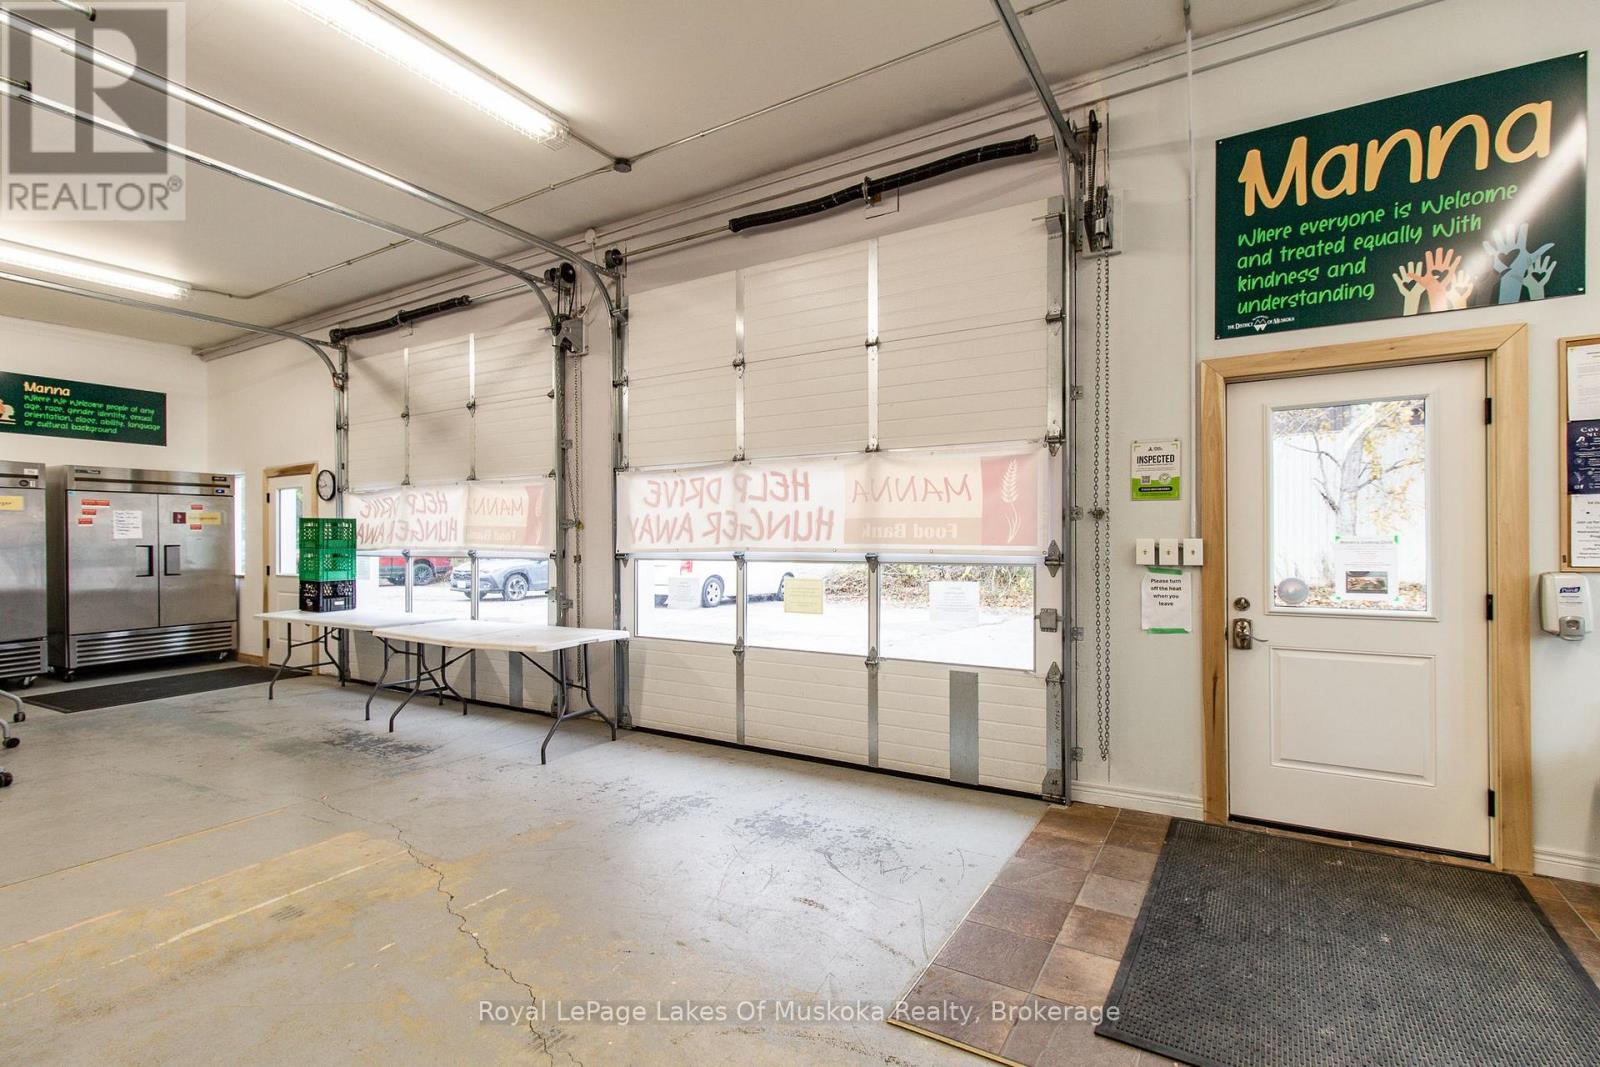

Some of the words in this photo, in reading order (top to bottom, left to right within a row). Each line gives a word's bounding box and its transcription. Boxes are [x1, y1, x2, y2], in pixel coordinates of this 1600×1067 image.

[1237, 100, 1553, 217] Manna
[1237, 227, 1293, 248] Where
[1299, 209, 1386, 238] everyone
[1393, 201, 1412, 220] is
[1421, 184, 1518, 216] Welcome
[1237, 249, 1272, 270] and
[1280, 241, 1345, 263] treated
[1353, 224, 1423, 252] equally
[1237, 268, 1320, 292] kindness
[1327, 256, 1366, 279] and
[1237, 282, 1375, 315] understanding
[23, 381, 71, 396] Manna
[1136, 454, 1175, 464] INSPECTED
